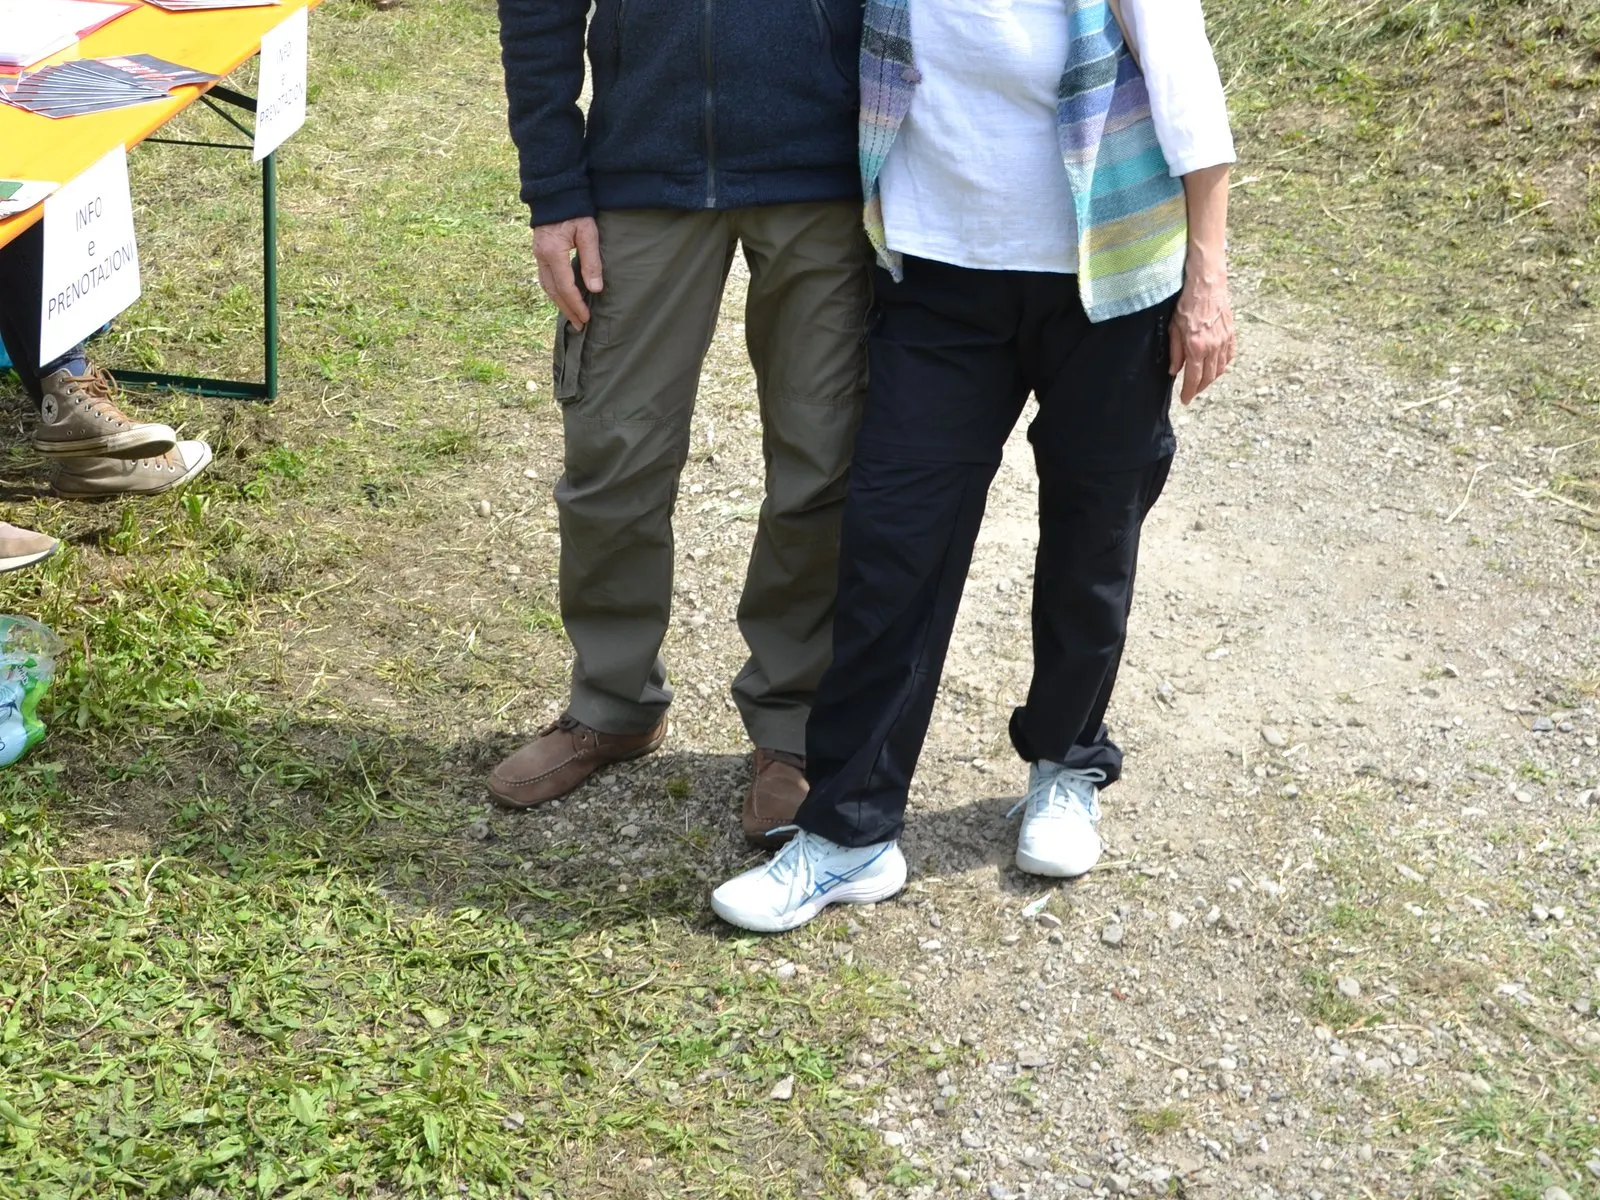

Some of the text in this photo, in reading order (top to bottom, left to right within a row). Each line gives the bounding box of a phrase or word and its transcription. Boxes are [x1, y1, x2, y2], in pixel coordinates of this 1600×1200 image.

[75, 196, 102, 232] INFO
[88, 240, 96, 256] e
[48, 240, 134, 320] PRENOTAZIONI
